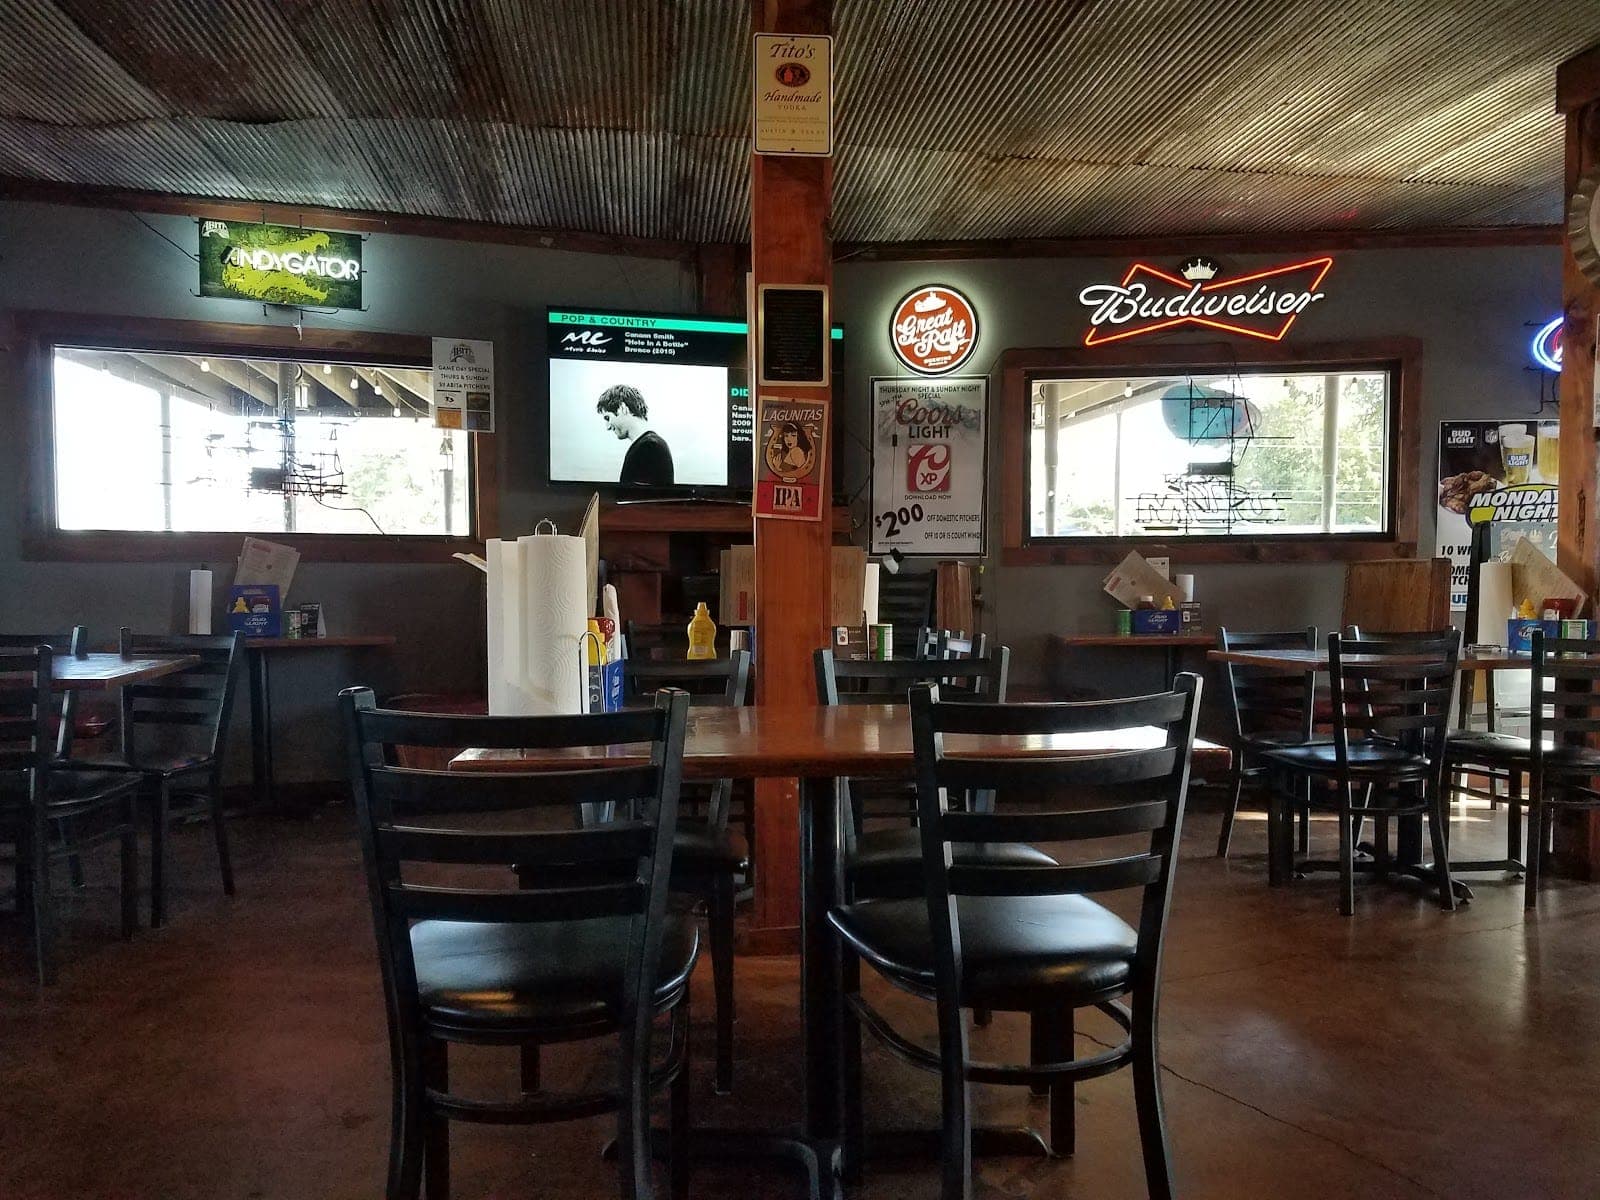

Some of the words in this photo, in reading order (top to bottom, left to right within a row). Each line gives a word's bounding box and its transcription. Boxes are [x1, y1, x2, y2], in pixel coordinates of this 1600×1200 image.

[770, 41, 816, 59] Tito's
[764, 89, 822, 103] Handmade
[220, 246, 360, 281] ANDYGATOR
[1079, 283, 1325, 326] Budweiser
[561, 314, 585, 323] POP
[601, 317, 657, 327] COUNTRY
[896, 307, 954, 346] Great
[653, 333, 675, 341] Smith
[913, 319, 970, 358] Raft
[879, 386, 910, 394] THURSDAY
[762, 409, 823, 422] LAGUNITAS
[896, 399, 963, 425] Coors
[908, 425, 951, 439] LIGHT
[1447, 436, 1476, 444] LIGHT
[920, 472, 938, 485] XP
[775, 487, 801, 507] IPA
[926, 514, 936, 522] OFF
[936, 514, 959, 522] DOMESTIC
[960, 514, 980, 522] PITCHERS
[924, 532, 933, 540] OFF
[1442, 545, 1454, 556] 10
